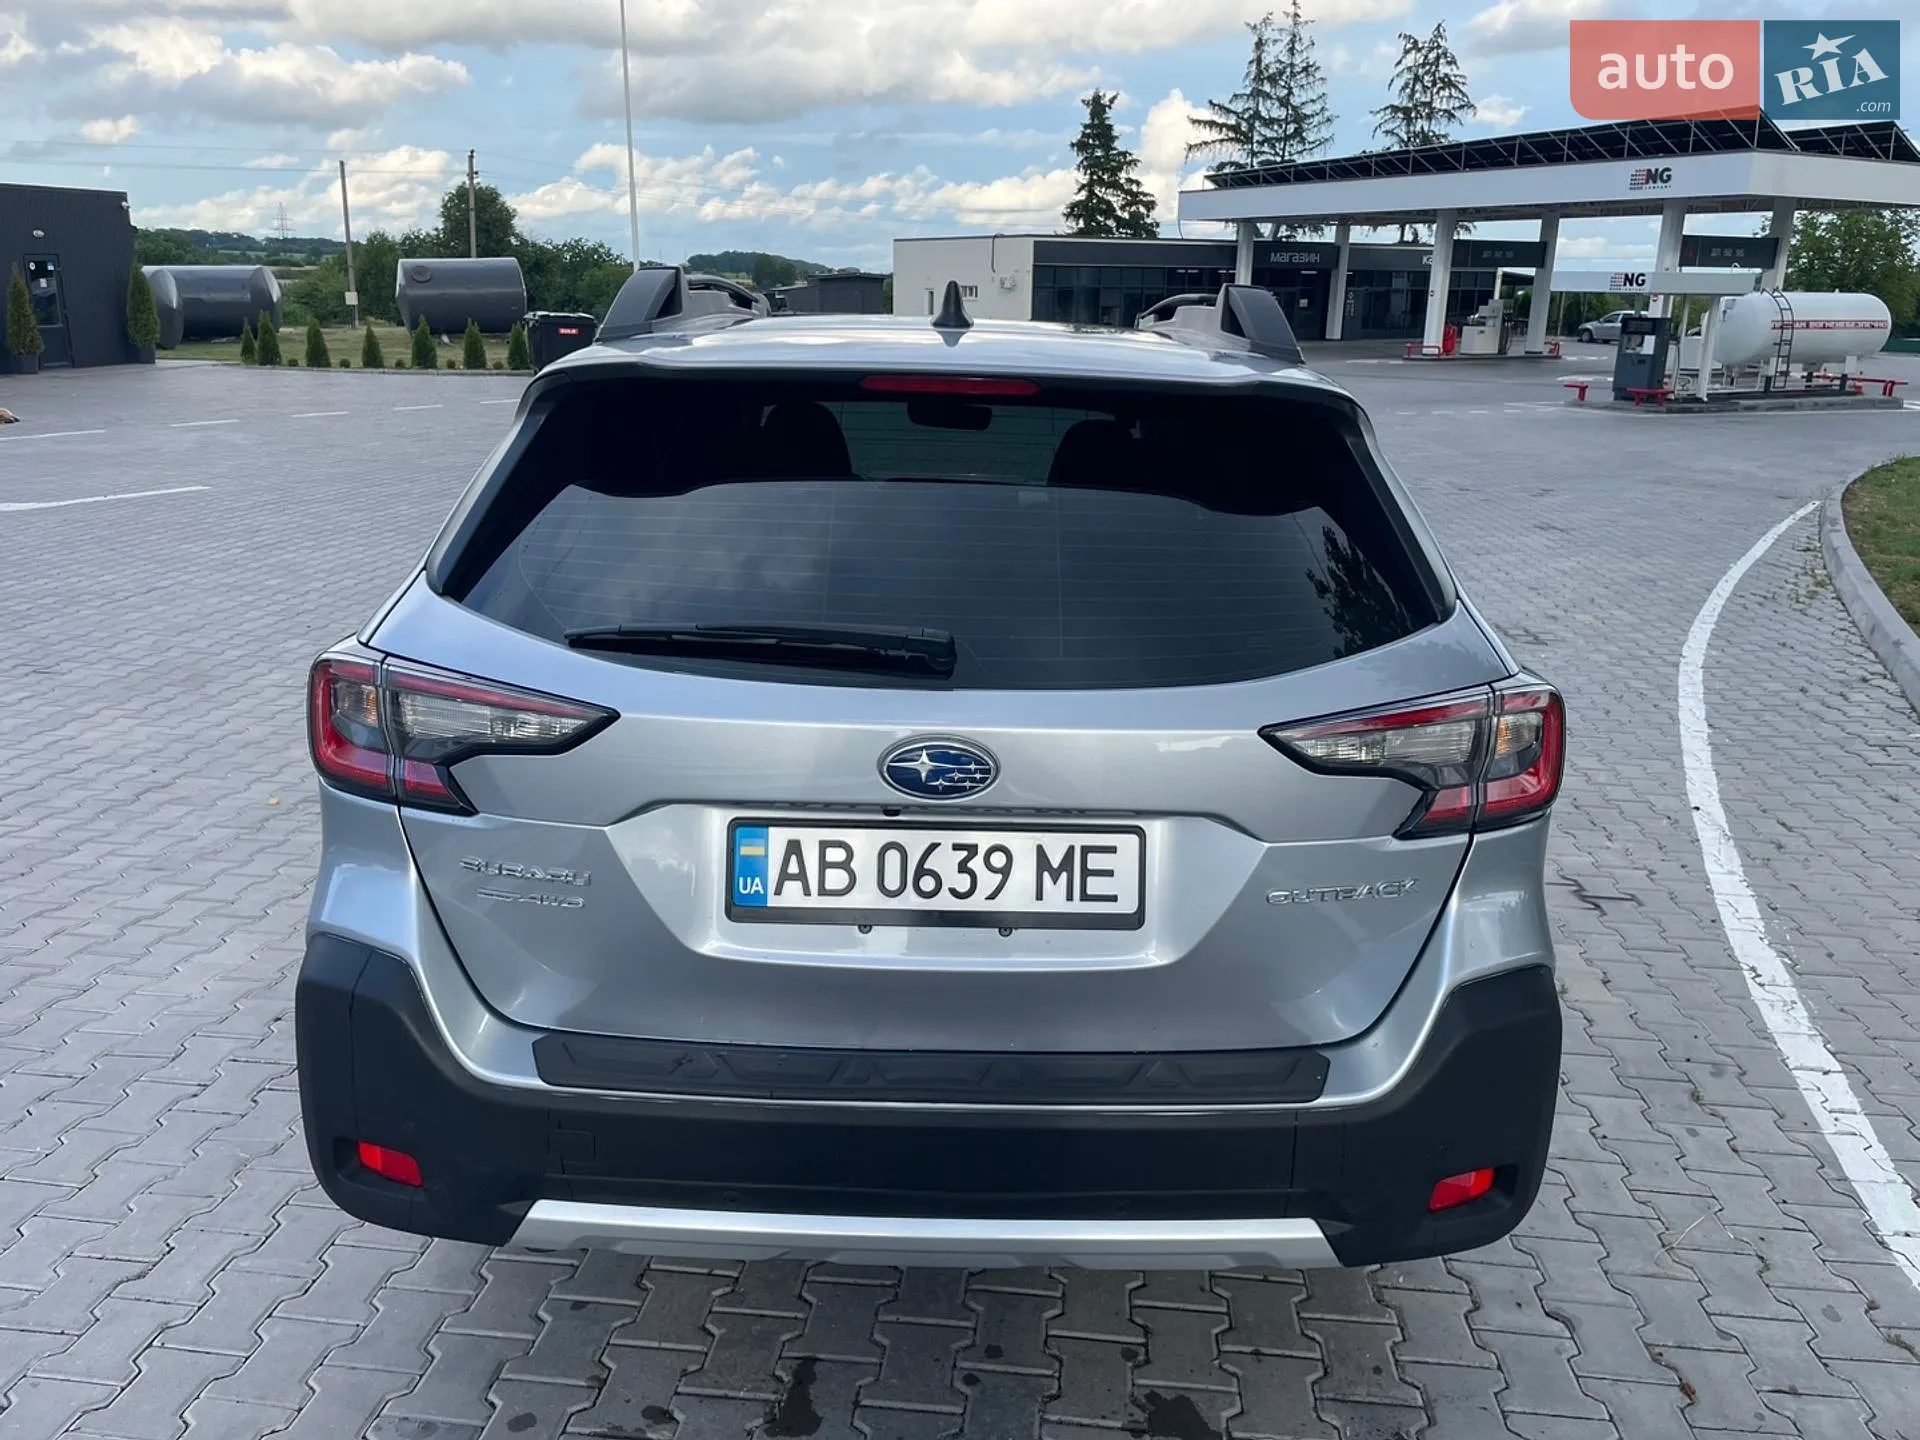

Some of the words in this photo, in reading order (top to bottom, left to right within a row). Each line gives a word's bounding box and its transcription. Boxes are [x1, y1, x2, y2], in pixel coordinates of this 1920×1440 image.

[1270, 252, 1320, 264] магазин
[773, 839, 857, 897] AB
[877, 840, 1013, 901] 0639
[1034, 843, 1119, 903] ME
[738, 876, 765, 895] UA
[1266, 878, 1417, 905] OUTBACK
